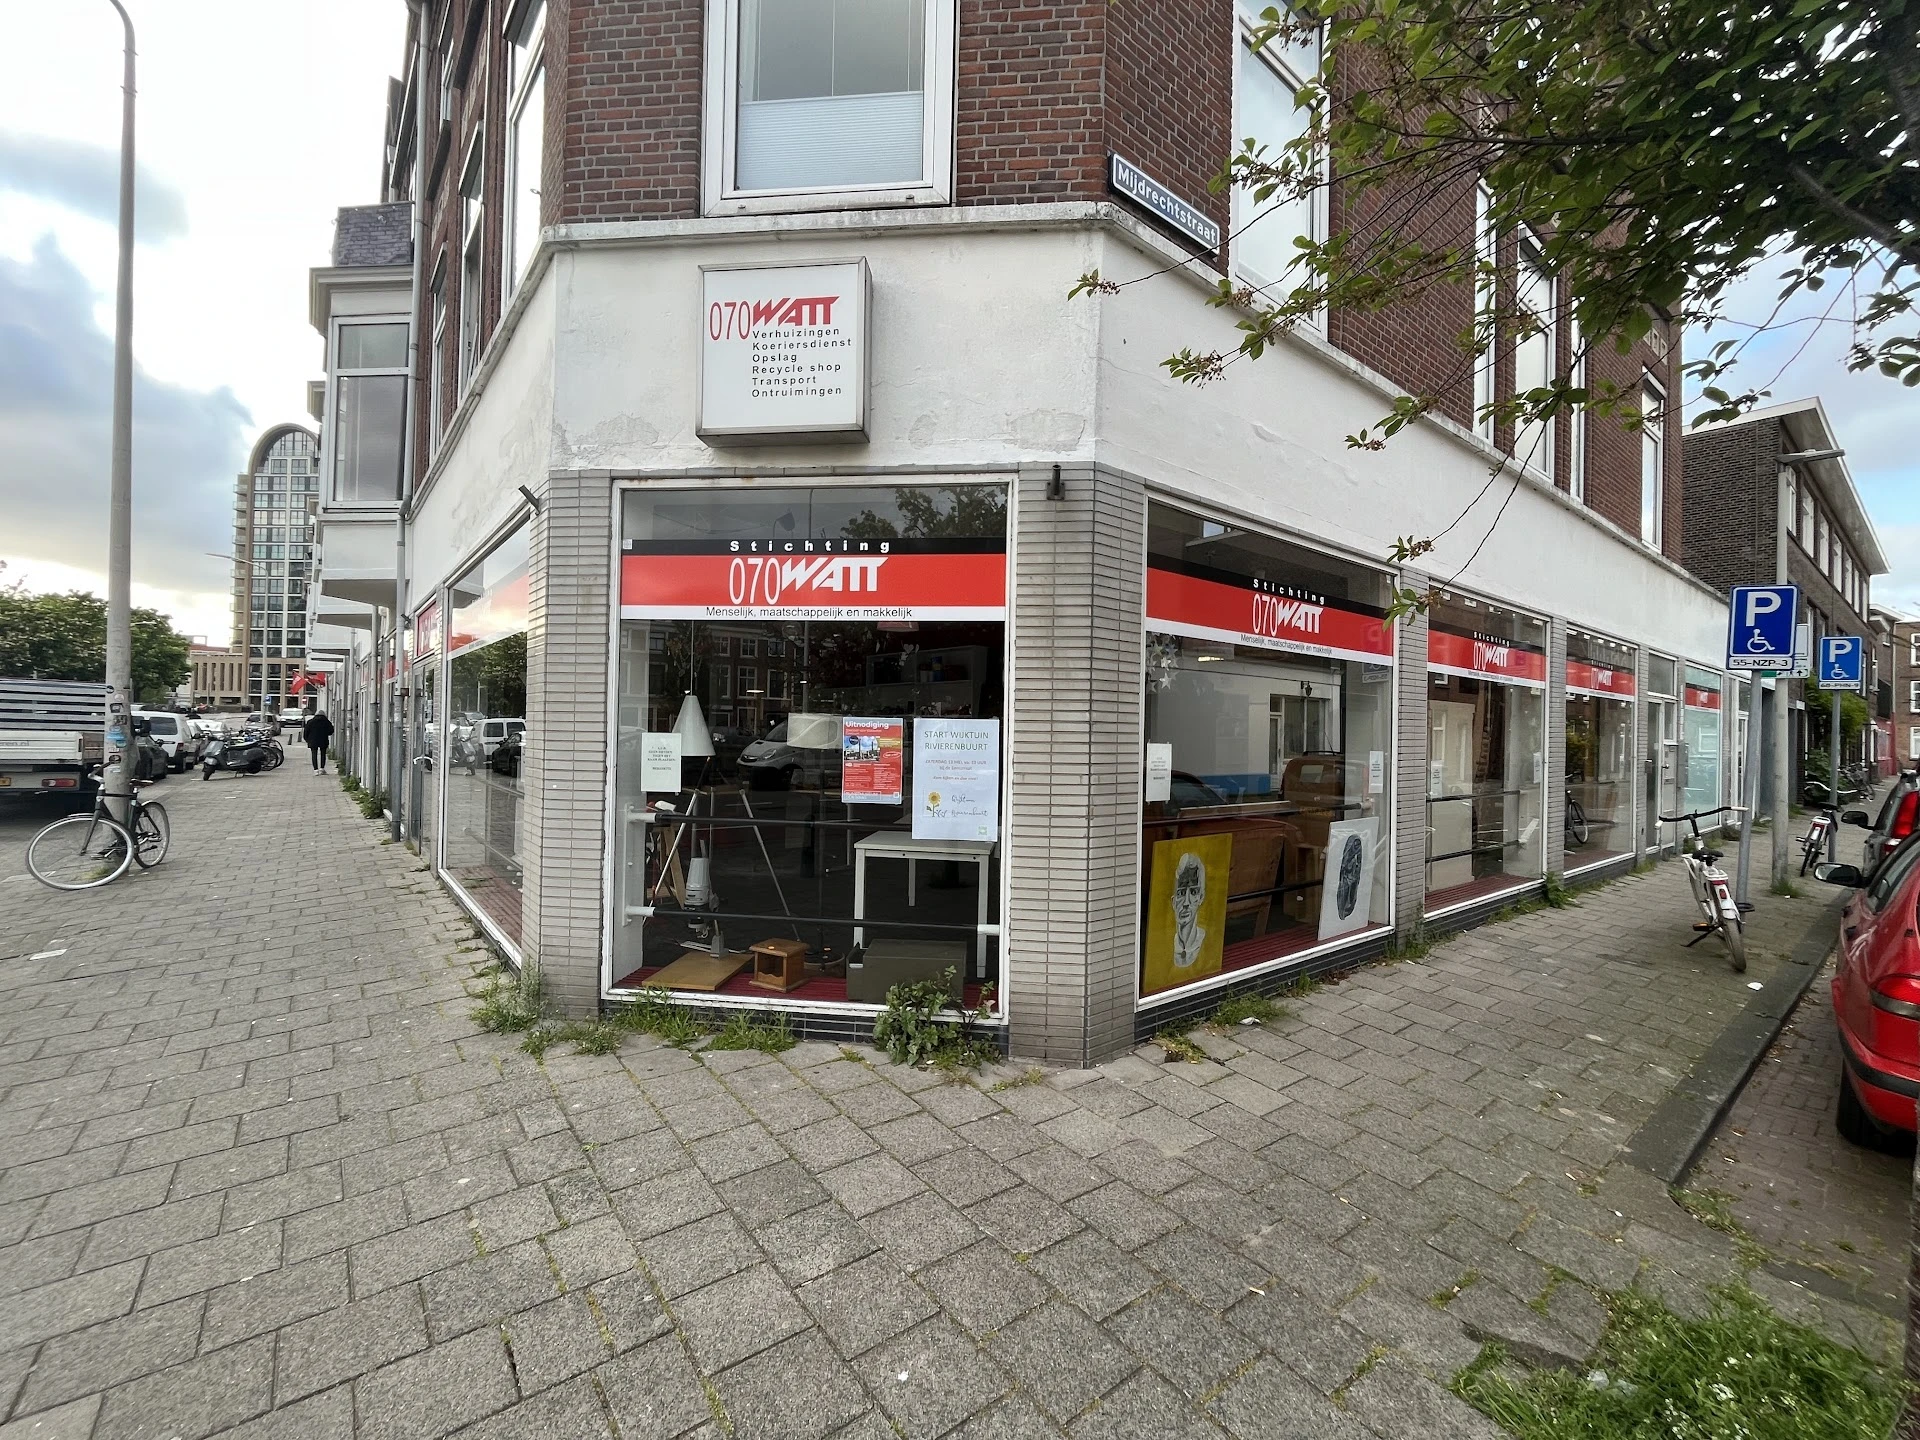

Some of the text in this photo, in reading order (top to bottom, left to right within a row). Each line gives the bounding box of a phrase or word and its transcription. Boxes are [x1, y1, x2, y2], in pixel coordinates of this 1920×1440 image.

[1117, 163, 1216, 244] Mijdrechtstraat
[752, 327, 840, 339] Verhuizingen
[752, 338, 852, 351] Koeriersdienst
[752, 353, 798, 363] Opslag
[752, 362, 841, 375] Recycle shop
[752, 375, 817, 386] Transport
[752, 386, 842, 398] Ontruimingen
[730, 540, 890, 553] Stichting
[1253, 578, 1325, 605] Stichting
[705, 606, 912, 619] Menselijk, maatschappelijk en makkelijk
[1745, 591, 1782, 627] P
[1473, 631, 1510, 648] Stichting
[1828, 639, 1853, 663] P
[1732, 659, 1788, 667] 55-NZP-3
[845, 721, 890, 730] Uitnodiging
[924, 730, 989, 739] START WIJKTUIN
[924, 742, 988, 751] RIVIERENBUURT
